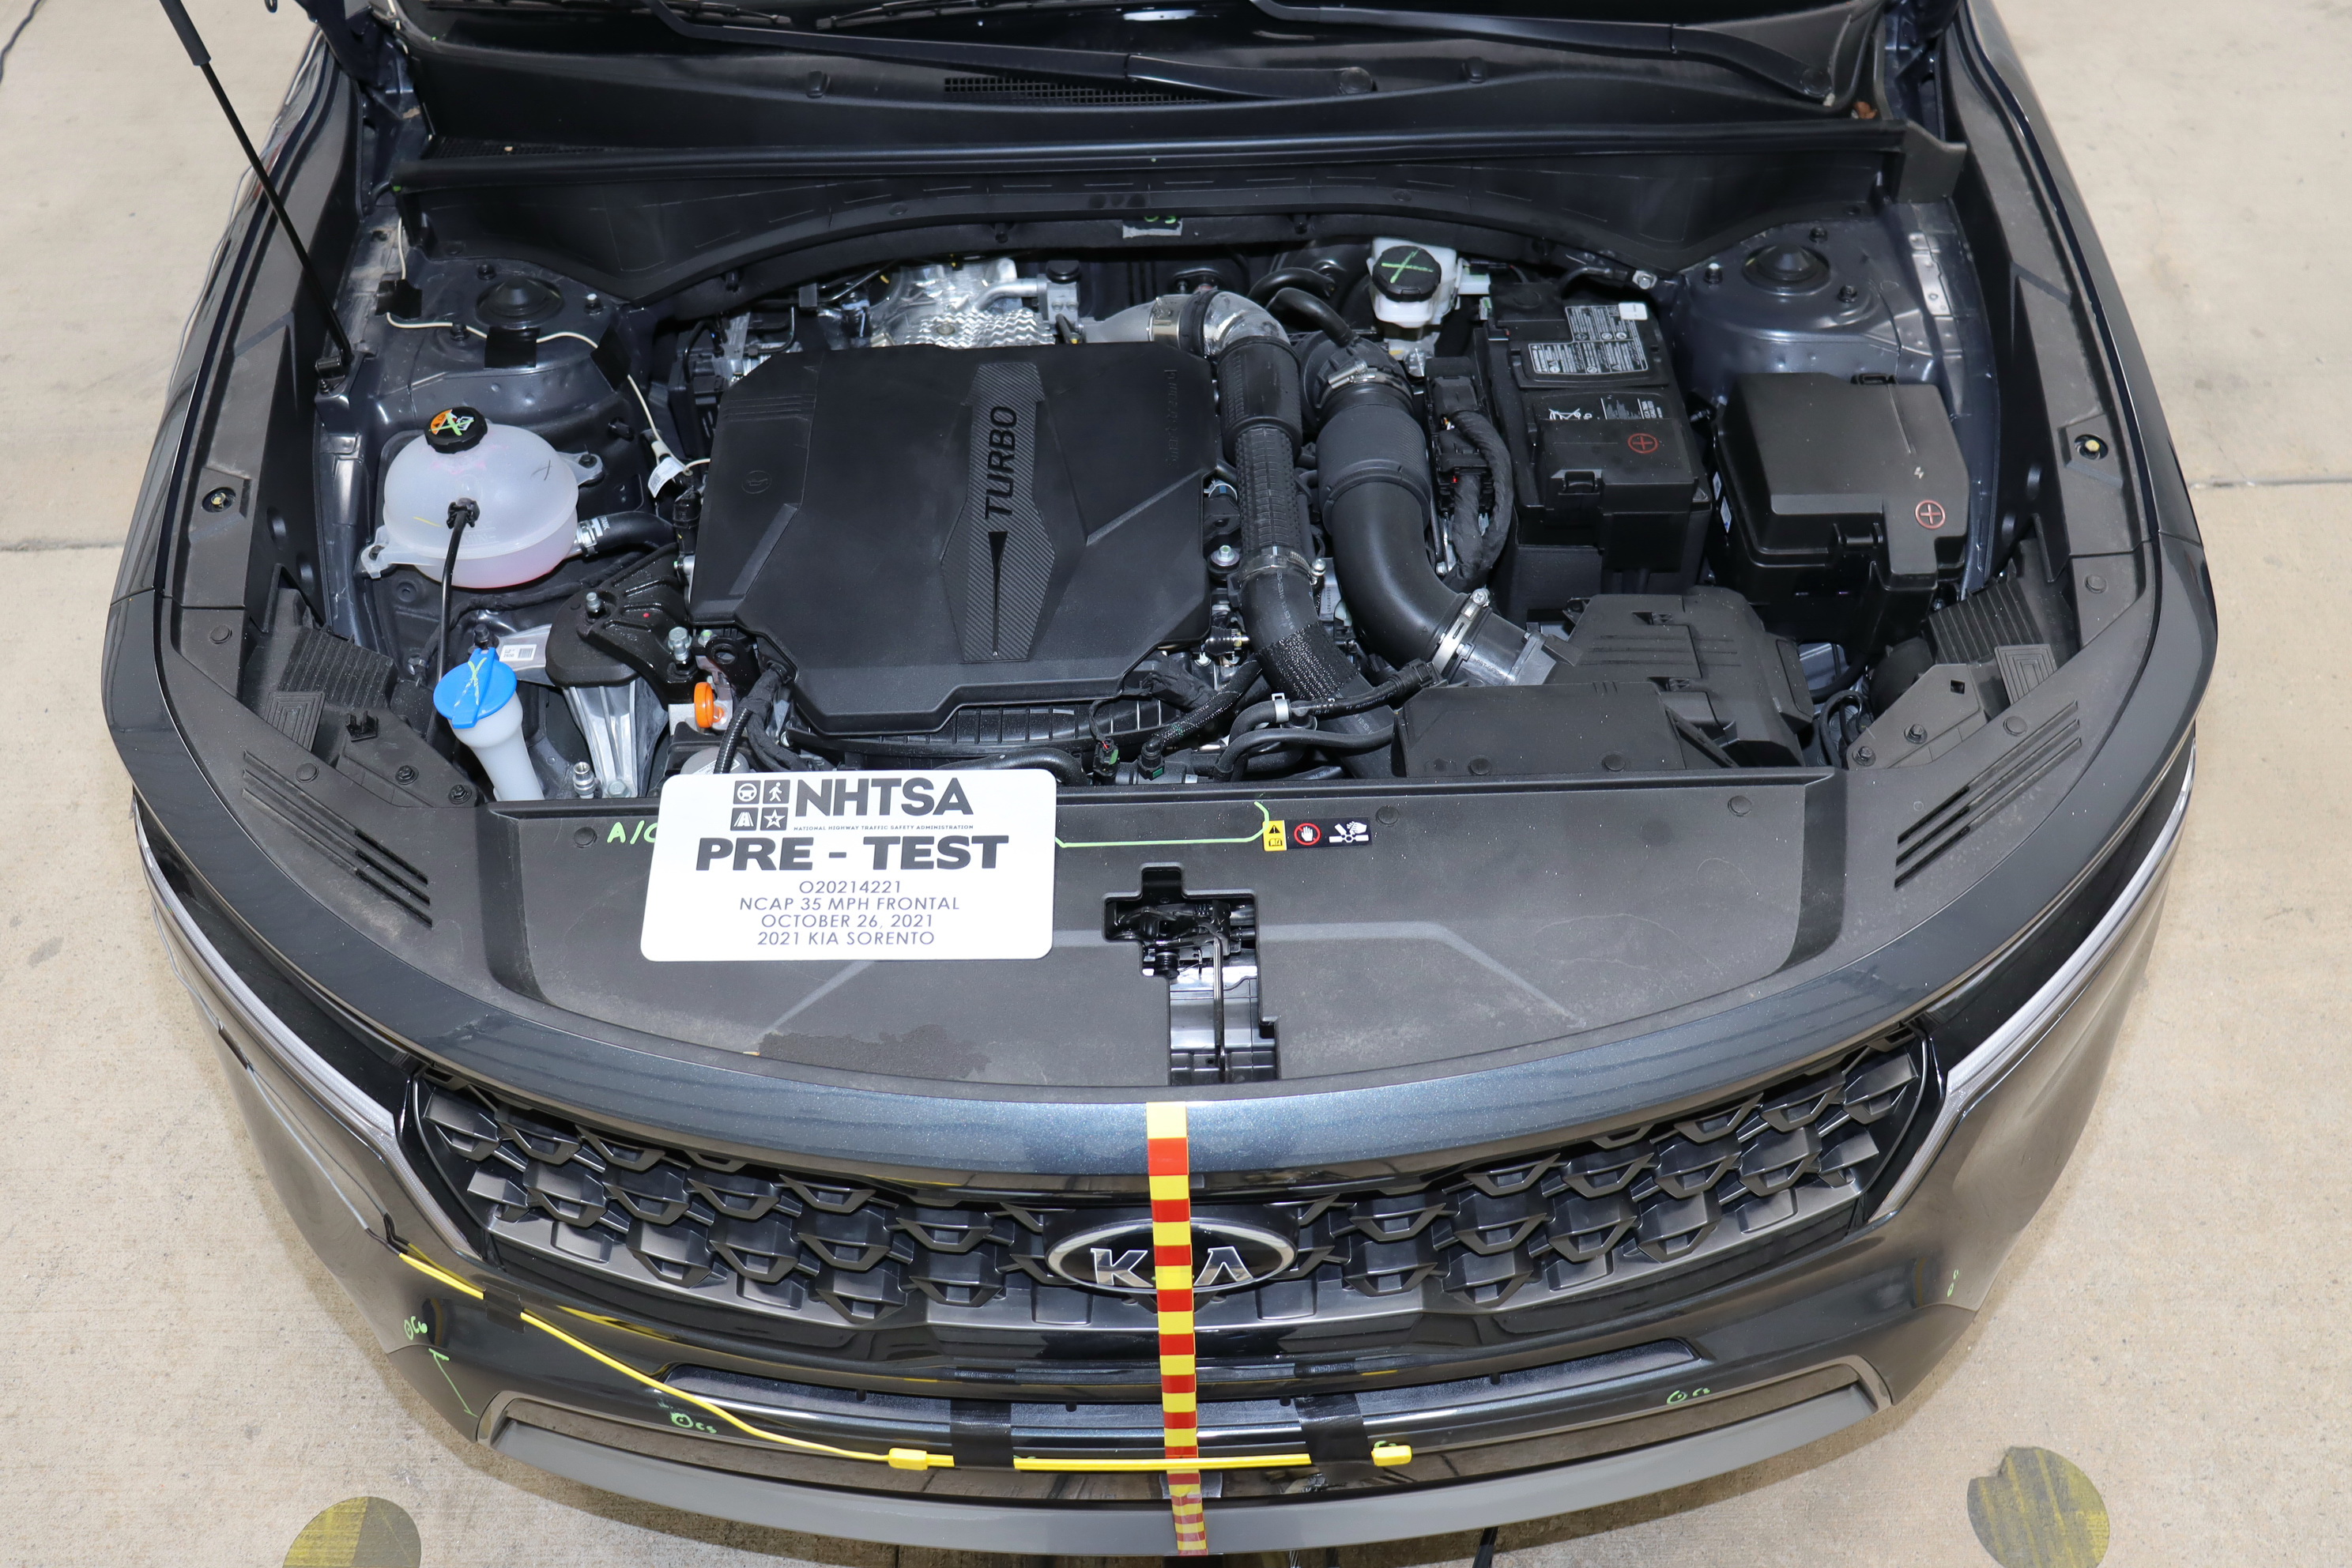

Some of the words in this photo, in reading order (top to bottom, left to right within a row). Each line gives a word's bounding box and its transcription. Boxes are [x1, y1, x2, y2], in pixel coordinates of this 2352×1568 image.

[985, 405, 1017, 519] TURBO
[795, 778, 974, 817] NHTSA
[695, 836, 814, 871] PRE
[863, 835, 1009, 870] TEST
[740, 897, 794, 910] NCAP
[801, 897, 822, 910] 35
[827, 897, 870, 910] MPH
[876, 897, 959, 910] FRONTAL
[761, 914, 850, 928] OCTOBER
[857, 914, 884, 929] 26,
[891, 913, 933, 927] 2021
[757, 931, 800, 945] 2021
[808, 931, 839, 945] KIA
[846, 931, 935, 945] SORENTO
[1090, 1246, 1254, 1288] KA
